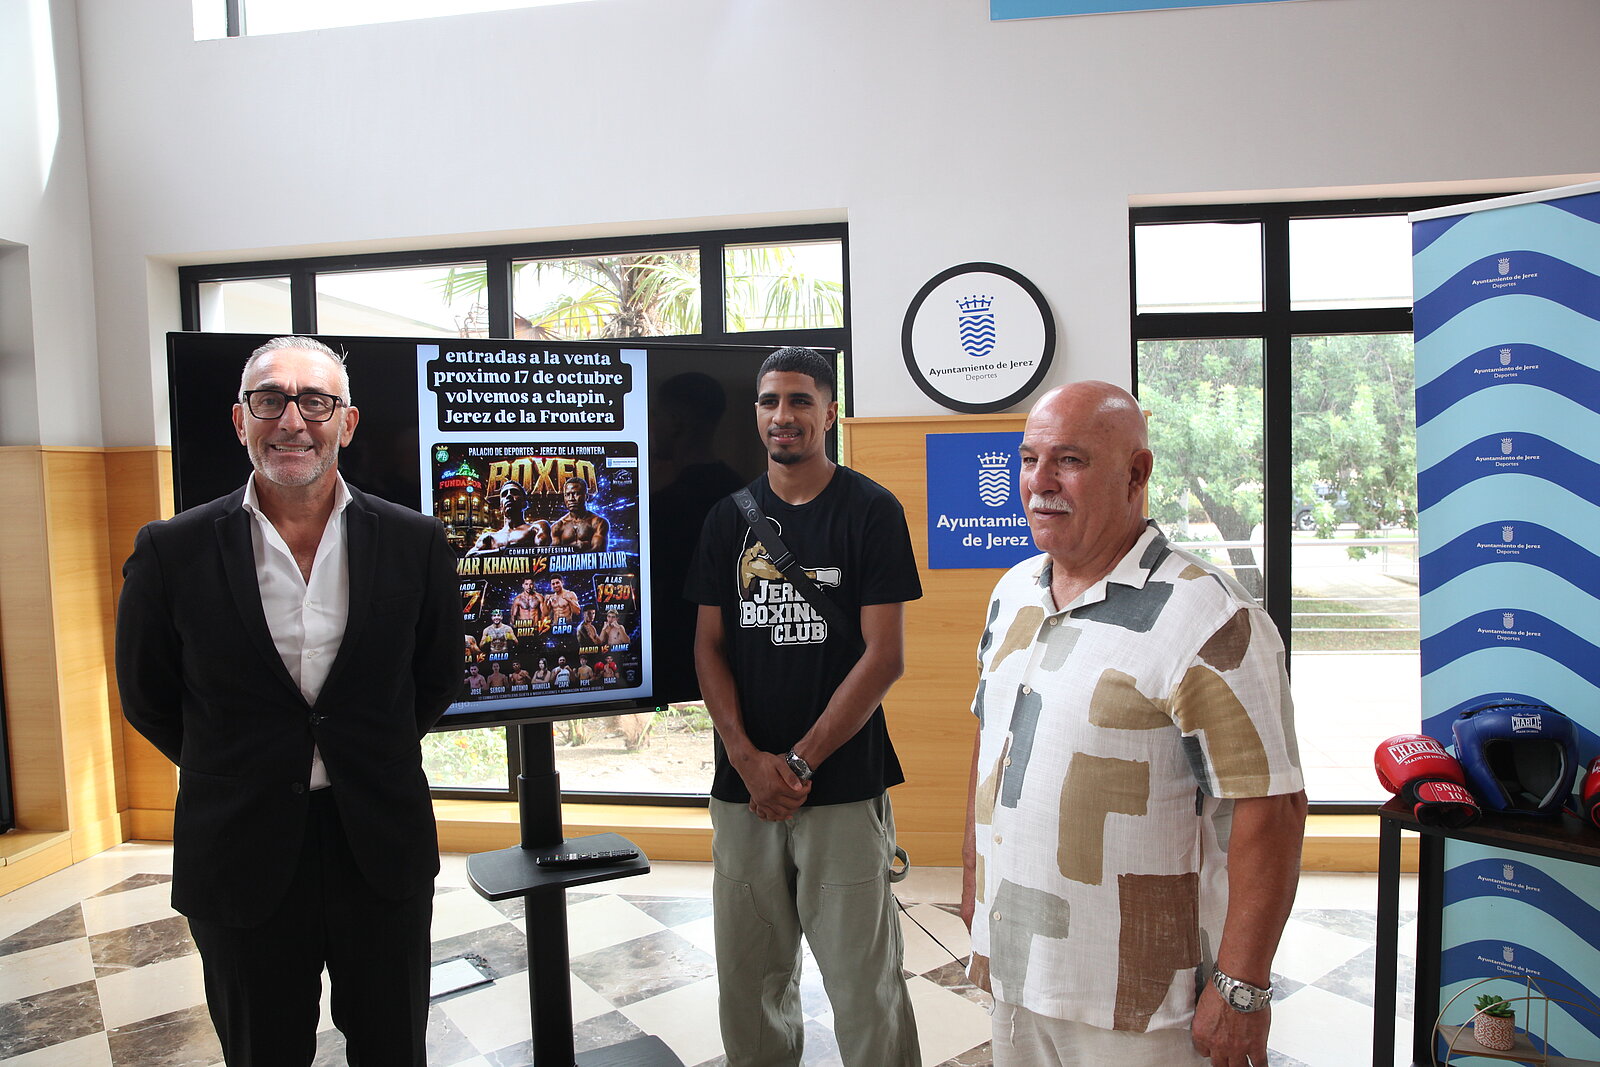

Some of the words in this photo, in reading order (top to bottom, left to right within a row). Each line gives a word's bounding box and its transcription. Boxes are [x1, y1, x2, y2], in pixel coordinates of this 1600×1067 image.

[1472, 276, 1512, 285] Ayuntamiento
[446, 350, 526, 365] entradas
[529, 353, 540, 364] a
[544, 351, 560, 365] la
[564, 352, 611, 366] venta
[929, 363, 994, 377] Ayuntamiento
[1010, 360, 1033, 370] Jerez
[965, 372, 997, 381] Deportes
[433, 369, 511, 386] proximo
[514, 370, 529, 384] 17
[532, 370, 554, 384] de
[556, 371, 623, 385] octubre
[445, 390, 529, 404] volvemos
[531, 393, 542, 404] a
[546, 390, 606, 408] chapin
[445, 410, 491, 424] Jerez
[494, 410, 517, 423] de
[520, 410, 536, 423] la
[540, 410, 615, 423] Frontera
[468, 447, 493, 456] PALACIO
[495, 447, 503, 456] DE
[504, 447, 534, 456] DEPORTES
[540, 447, 557, 455] JEREZ
[558, 447, 566, 455] DE
[567, 447, 574, 455] LA
[576, 447, 605, 455] FRONTERA
[439, 479, 482, 489] FUNDAOR
[485, 456, 598, 501] BOXEO
[962, 533, 982, 547] de
[986, 533, 1028, 549] Jerez
[483, 557, 530, 574] KHAYATI
[533, 555, 547, 576] VS
[549, 553, 597, 572] GADATAMEN
[598, 551, 627, 568] TAYLOR
[460, 590, 481, 612] 7
[597, 584, 630, 602] 19:30
[517, 628, 534, 636] RUIZ
[538, 618, 551, 636] VS
[552, 625, 572, 634] CAPO
[774, 622, 825, 643] CLUB
[579, 646, 599, 654] MARIO
[601, 644, 609, 653] VS
[476, 653, 486, 662] VS
[489, 653, 508, 661] GALLO
[1512, 714, 1542, 731] CHARLIE
[1434, 784, 1472, 797] SNIP
[1477, 875, 1516, 887] Ayuntamiento
[1497, 885, 1520, 893] Deportes
[1477, 955, 1516, 969] Ayuntamiento
[1526, 966, 1540, 975] Jerez
[1497, 966, 1520, 975] Deportes
